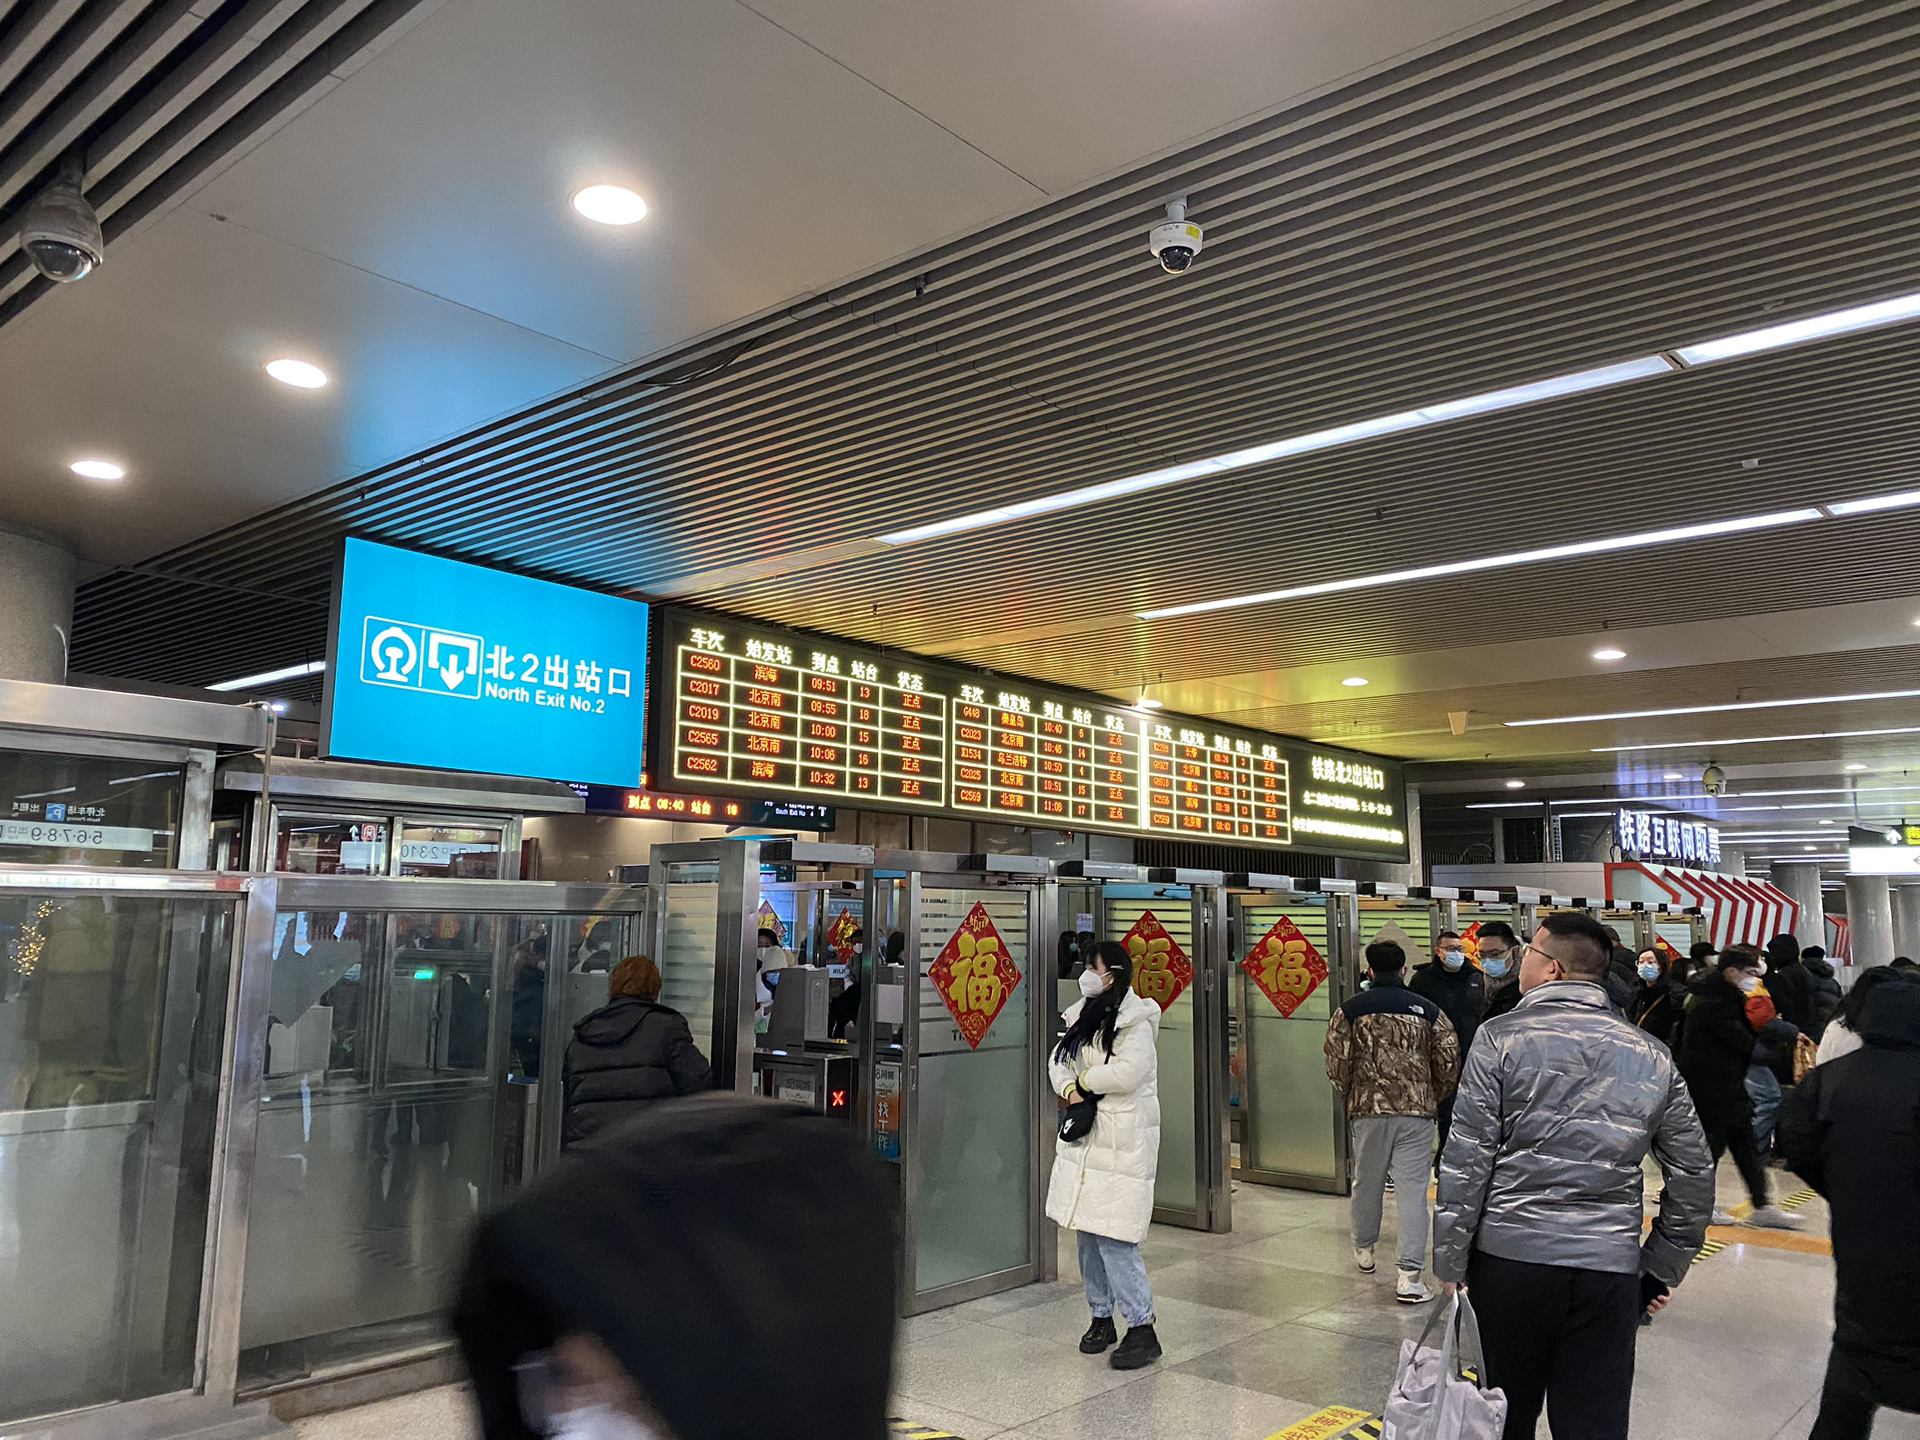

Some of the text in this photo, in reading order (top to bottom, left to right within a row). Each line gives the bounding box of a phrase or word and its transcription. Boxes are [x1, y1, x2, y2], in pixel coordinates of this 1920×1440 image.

[484, 644, 631, 698] 北2出站口
[690, 628, 923, 691] 车次 始发站 到点 站台 状态
[485, 681, 605, 714] North Exit No.2
[690, 655, 921, 709] C2560 滨海 09:51 13 正点
[689, 681, 921, 730] C2017 北京南 09:55 18 正点
[961, 684, 985, 704] 车次
[998, 692, 1031, 713] 始发站
[1073, 707, 1092, 725] 站台
[688, 705, 921, 751] C2019 北京南 10:00 15 正点
[961, 727, 981, 740] C2023
[1001, 732, 1024, 747] 北京南
[1044, 722, 1063, 734] 10:40
[688, 730, 921, 772] C2565 北京南 10:06 16 正点
[1044, 760, 1063, 772] 10:50
[687, 756, 920, 795] C2562 滨海 10:32 13 正点
[1001, 771, 1024, 786] 北京南
[1044, 780, 1062, 792] 10:51
[1078, 785, 1086, 795] 15
[691, 800, 711, 815] 站台
[960, 790, 982, 802] C2569
[1001, 792, 1024, 807] 北京南
[1078, 805, 1086, 815] 17
[1619, 807, 1721, 863] 铁路互联网取票
[949, 931, 1001, 1016] 福
[1127, 933, 1175, 1003] 福
[1260, 935, 1311, 996] 福
